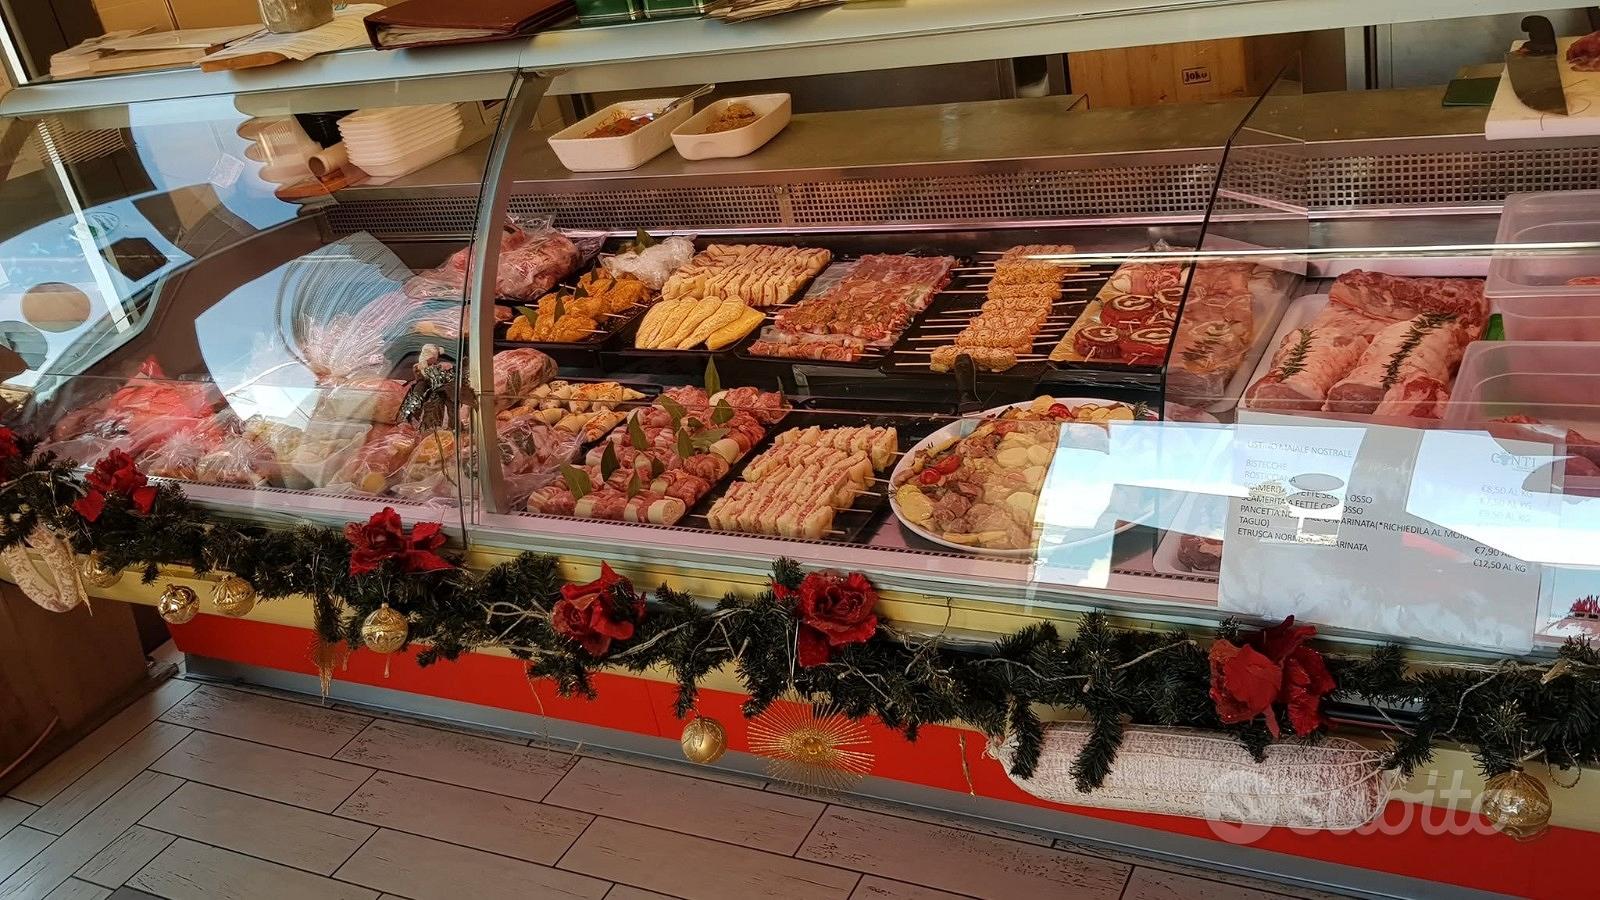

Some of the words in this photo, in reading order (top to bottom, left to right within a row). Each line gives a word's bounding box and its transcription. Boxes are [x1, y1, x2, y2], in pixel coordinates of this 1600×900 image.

[1311, 447, 1352, 458] NOSTRALE
[1246, 459, 1288, 471] BISTECCHE
[1295, 499, 1319, 510] FETTE
[1350, 494, 1373, 505] OSSO
[1239, 515, 1270, 528] TAGLIO)
[1240, 504, 1280, 518] PANCETTA
[1431, 528, 1441, 537] AL
[1237, 527, 1273, 539] ETRUSCA
[1474, 545, 1500, 558] €7,90
[1473, 558, 1501, 570] €12,50
[1502, 562, 1513, 571] AL
[1515, 563, 1526, 574] KG
